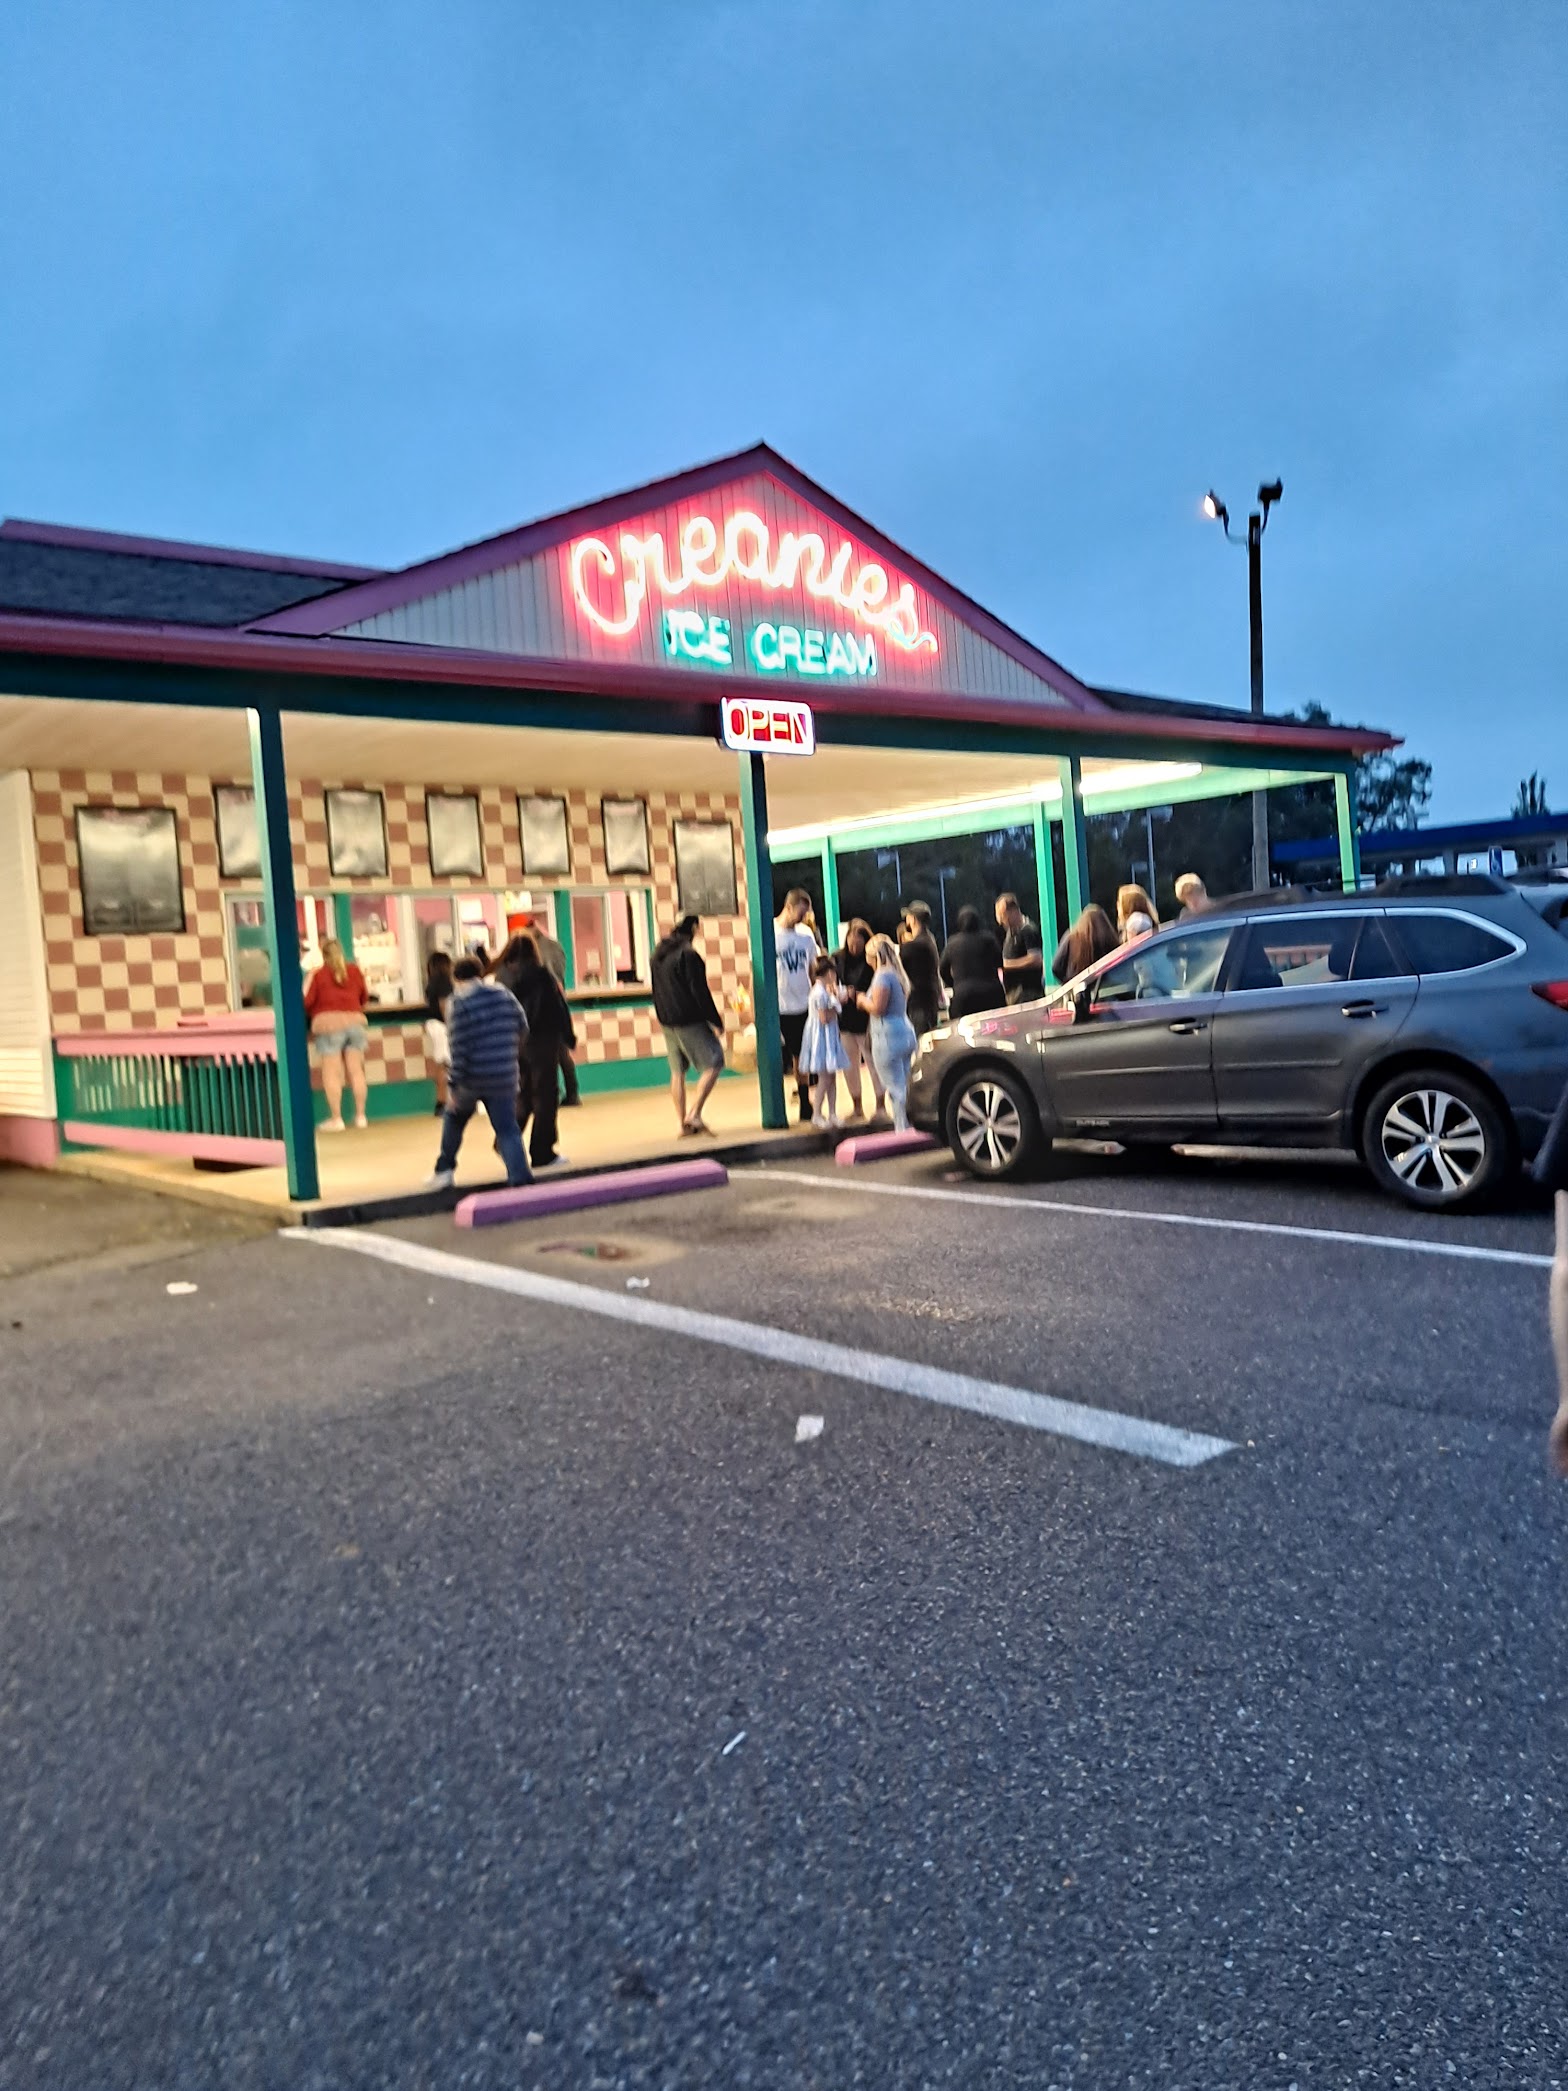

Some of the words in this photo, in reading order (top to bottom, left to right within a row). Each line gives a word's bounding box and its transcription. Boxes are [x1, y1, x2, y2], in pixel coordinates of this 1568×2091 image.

[667, 609, 732, 665] ICE
[753, 622, 878, 676] CREAM
[727, 705, 809, 745] OPEN
